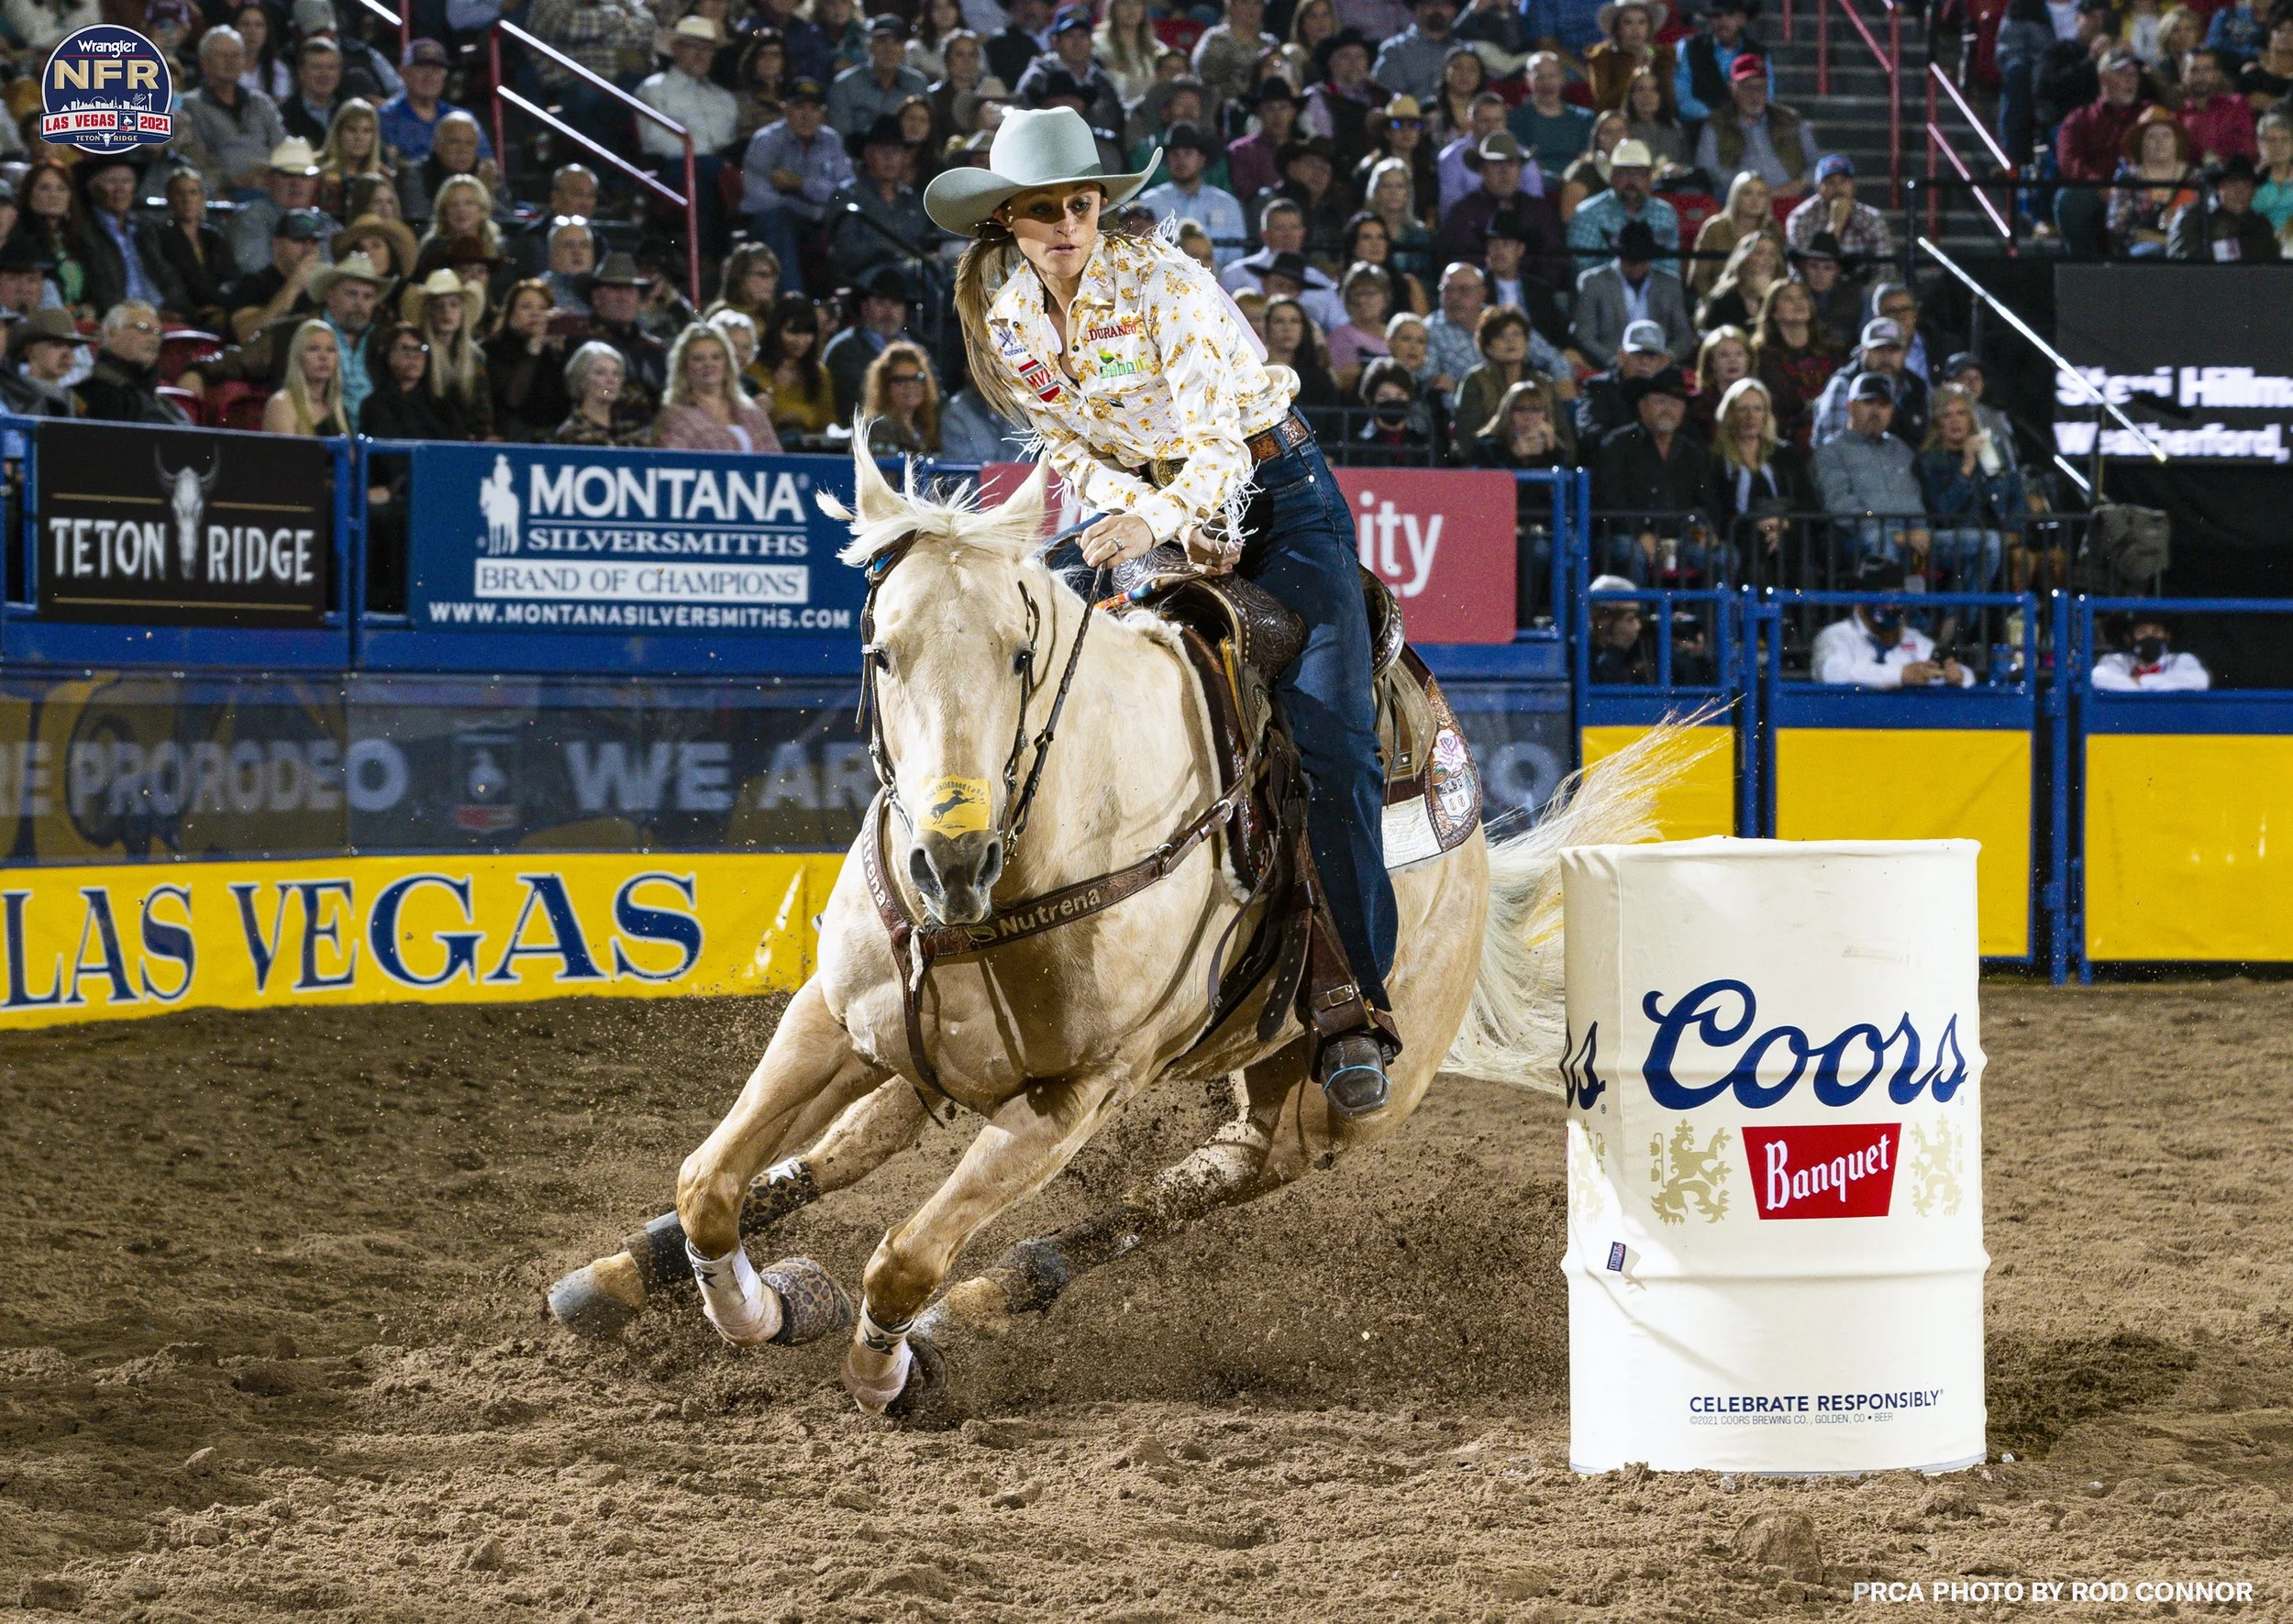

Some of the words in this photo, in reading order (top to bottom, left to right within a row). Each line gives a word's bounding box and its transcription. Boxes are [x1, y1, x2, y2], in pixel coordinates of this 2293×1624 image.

[1089, 323, 1137, 341] DURANGO
[528, 463, 807, 524] MONTANA
[49, 516, 167, 581] TETON
[206, 525, 316, 587] RIDGE
[527, 527, 808, 558] SILVERSMITHS
[481, 567, 581, 592] BRAND
[589, 568, 627, 593] OF
[636, 568, 800, 596] CHAMPIONS
[428, 601, 850, 629] WWW.MONTANASILVERSMITHS.COM
[70, 738, 409, 816] PRORODEO
[563, 740, 733, 812] WE
[999, 887, 1102, 937] Nutrena
[0, 883, 196, 1011] LAS
[227, 872, 704, 995] VEGAS
[1642, 978, 1968, 1110] Coors
[1764, 1132, 1892, 1212] Banquet
[1689, 1395, 1810, 1413] CELEBRATE
[1817, 1389, 1940, 1411] RESPONSIBLY
[1721, 1415, 1751, 1425] COORS
[1752, 1415, 1791, 1425] BREWING
[1814, 1413, 1852, 1424] GOLDEN,
[1854, 1413, 1866, 1423] CO
[1874, 1412, 1894, 1422] BEER
